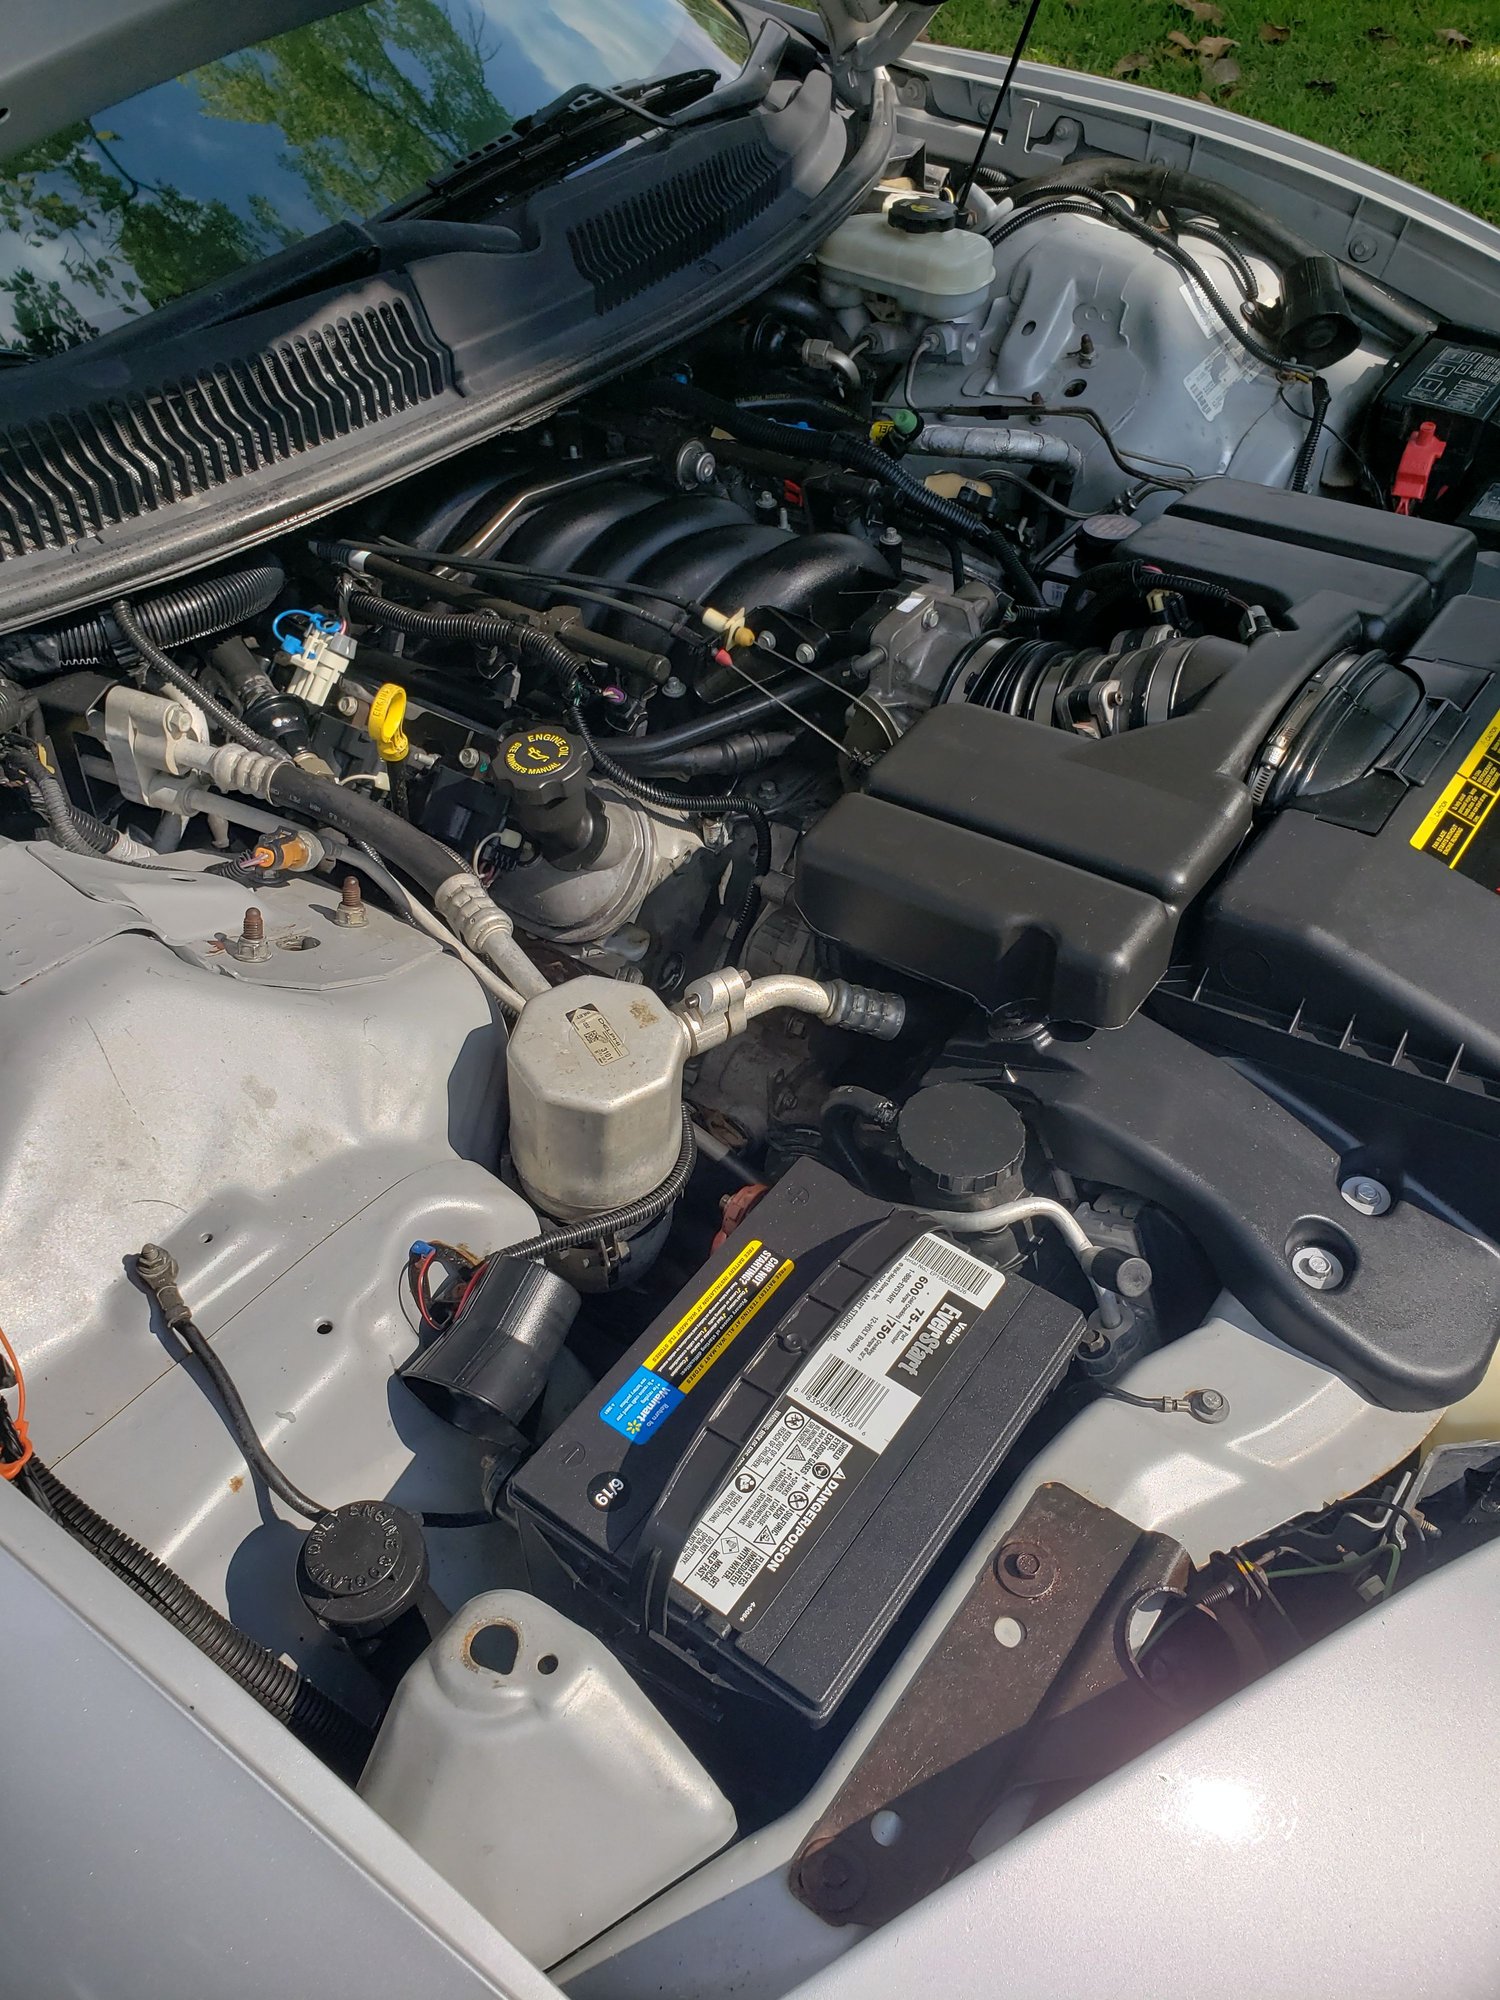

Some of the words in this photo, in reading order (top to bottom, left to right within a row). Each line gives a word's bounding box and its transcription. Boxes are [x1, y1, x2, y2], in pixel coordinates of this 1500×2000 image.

[1485, 726, 1498, 742] CAUTION
[508, 742, 522, 754] SEE
[528, 734, 566, 747] ENGINE
[558, 746, 569, 758] OIL
[507, 753, 527, 774] OWNER'S
[528, 762, 561, 775] MANUAL
[1434, 800, 1448, 817] CAUTION
[743, 1246, 755, 1258] FREE
[727, 1257, 745, 1276] BATTERY
[738, 1249, 772, 1285] STARTING?
[761, 1256, 779, 1273] CAR
[751, 1270, 768, 1287] NOT
[774, 1267, 786, 1280] FREE
[701, 1275, 729, 1306] INSTALLATION
[757, 1279, 776, 1300] BATTERY
[885, 1268, 915, 1304] 1-888-EVSTART
[909, 1275, 929, 1297] 600
[695, 1305, 704, 1313] AT
[731, 1297, 748, 1316] Primary
[740, 1300, 759, 1321] TESTING
[895, 1303, 911, 1320] Cranking
[860, 1315, 879, 1337] 12-VOLT
[901, 1306, 925, 1332] 75-1
[726, 1327, 736, 1337] ALL
[875, 1318, 896, 1341] 750
[890, 1329, 904, 1345] Number
[944, 1320, 967, 1346] Value
[700, 1334, 717, 1352] starting
[845, 1334, 864, 1354] Battery
[866, 1339, 882, 1356] Cranking
[897, 1301, 963, 1378] EverStart
[652, 1343, 669, 1362] STORES
[686, 1363, 705, 1384] STORES
[636, 1385, 671, 1423] Walmart
[651, 1403, 669, 1422] Return
[805, 1394, 830, 1412] 83996
[830, 1410, 855, 1428] 07176
[646, 1420, 654, 1428] to
[807, 1421, 815, 1429] OR
[773, 1426, 787, 1440] REACH
[780, 1430, 792, 1443] KEEP
[795, 1427, 811, 1444] INJURY.
[801, 1425, 821, 1448] BLINDNESS
[817, 1428, 828, 1439] CAN
[767, 1438, 778, 1448] OF
[774, 1441, 784, 1451] OUT
[806, 1437, 821, 1453] CAUSE
[811, 1432, 835, 1460] EXPLOSIVE
[827, 1437, 842, 1453] EYES.
[832, 1442, 849, 1461] SHIELD
[750, 1445, 771, 1470] CHILDREN.
[762, 1456, 773, 1466] THE
[768, 1449, 778, 1458] OF
[800, 1458, 816, 1475] GASES
[595, 1478, 623, 1505] 6/19
[801, 1483, 811, 1492] NO
[707, 1489, 737, 1525] INSTRUCTIONS.
[729, 1494, 742, 1509] READ
[749, 1492, 766, 1510] SEVERE
[751, 1496, 772, 1522] BLINDNESS
[768, 1501, 779, 1512] CAN
[723, 1506, 732, 1516] ALL
[737, 1508, 753, 1526] BURNS.
[757, 1510, 772, 1526] CAUSE
[772, 1505, 786, 1520] ACID
[745, 1520, 755, 1529] OR
[766, 1479, 840, 1572] DANGER/POISON
[770, 1510, 793, 1536] SULFURIC
[307, 1510, 341, 1555] ONLY
[686, 1535, 697, 1546] NOT
[693, 1528, 703, 1537] DO
[695, 1532, 709, 1546] OPEN
[705, 1536, 714, 1545] DO
[680, 1543, 699, 1565] BATTERY.
[697, 1543, 709, 1554] NOT
[705, 1549, 720, 1564] HELP
[736, 1546, 751, 1561] WITH
[694, 1562, 710, 1579] FAST.
[700, 1558, 723, 1584] MEDICAL
[721, 1559, 741, 1581] WATER.
[727, 1550, 758, 1587] IMMEDIATELY
[748, 1555, 764, 1574] FLUSH
[707, 1575, 720, 1588] GET
[738, 1571, 752, 1587] EYES
[739, 1601, 757, 1622] 4-5084
